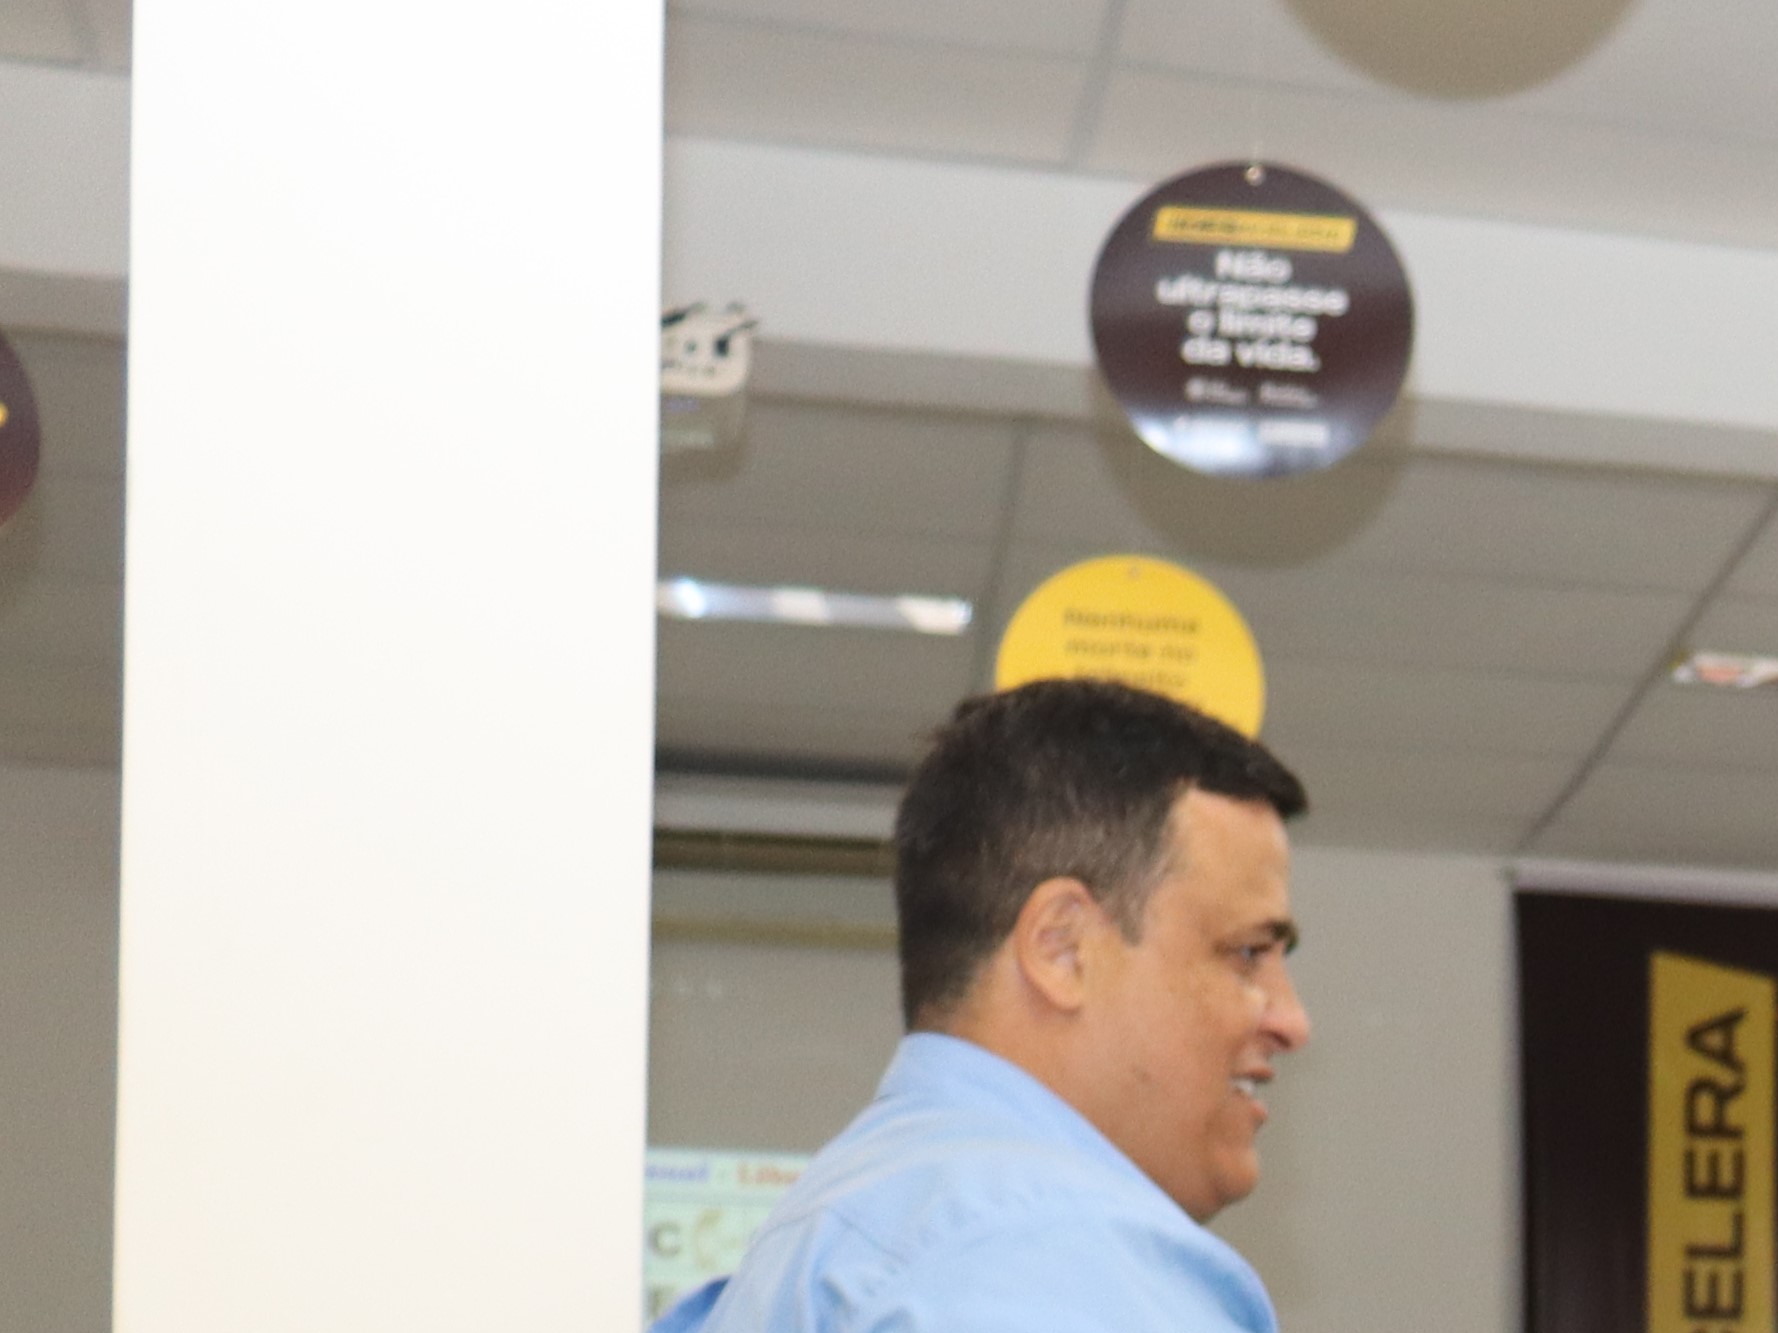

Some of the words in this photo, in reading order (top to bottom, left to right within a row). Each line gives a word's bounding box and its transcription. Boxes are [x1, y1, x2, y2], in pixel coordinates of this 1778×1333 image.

[1215, 250, 1291, 284] Não
[1156, 274, 1349, 316] ultrapasse
[1217, 308, 1318, 342] limite
[1181, 337, 1232, 365] da
